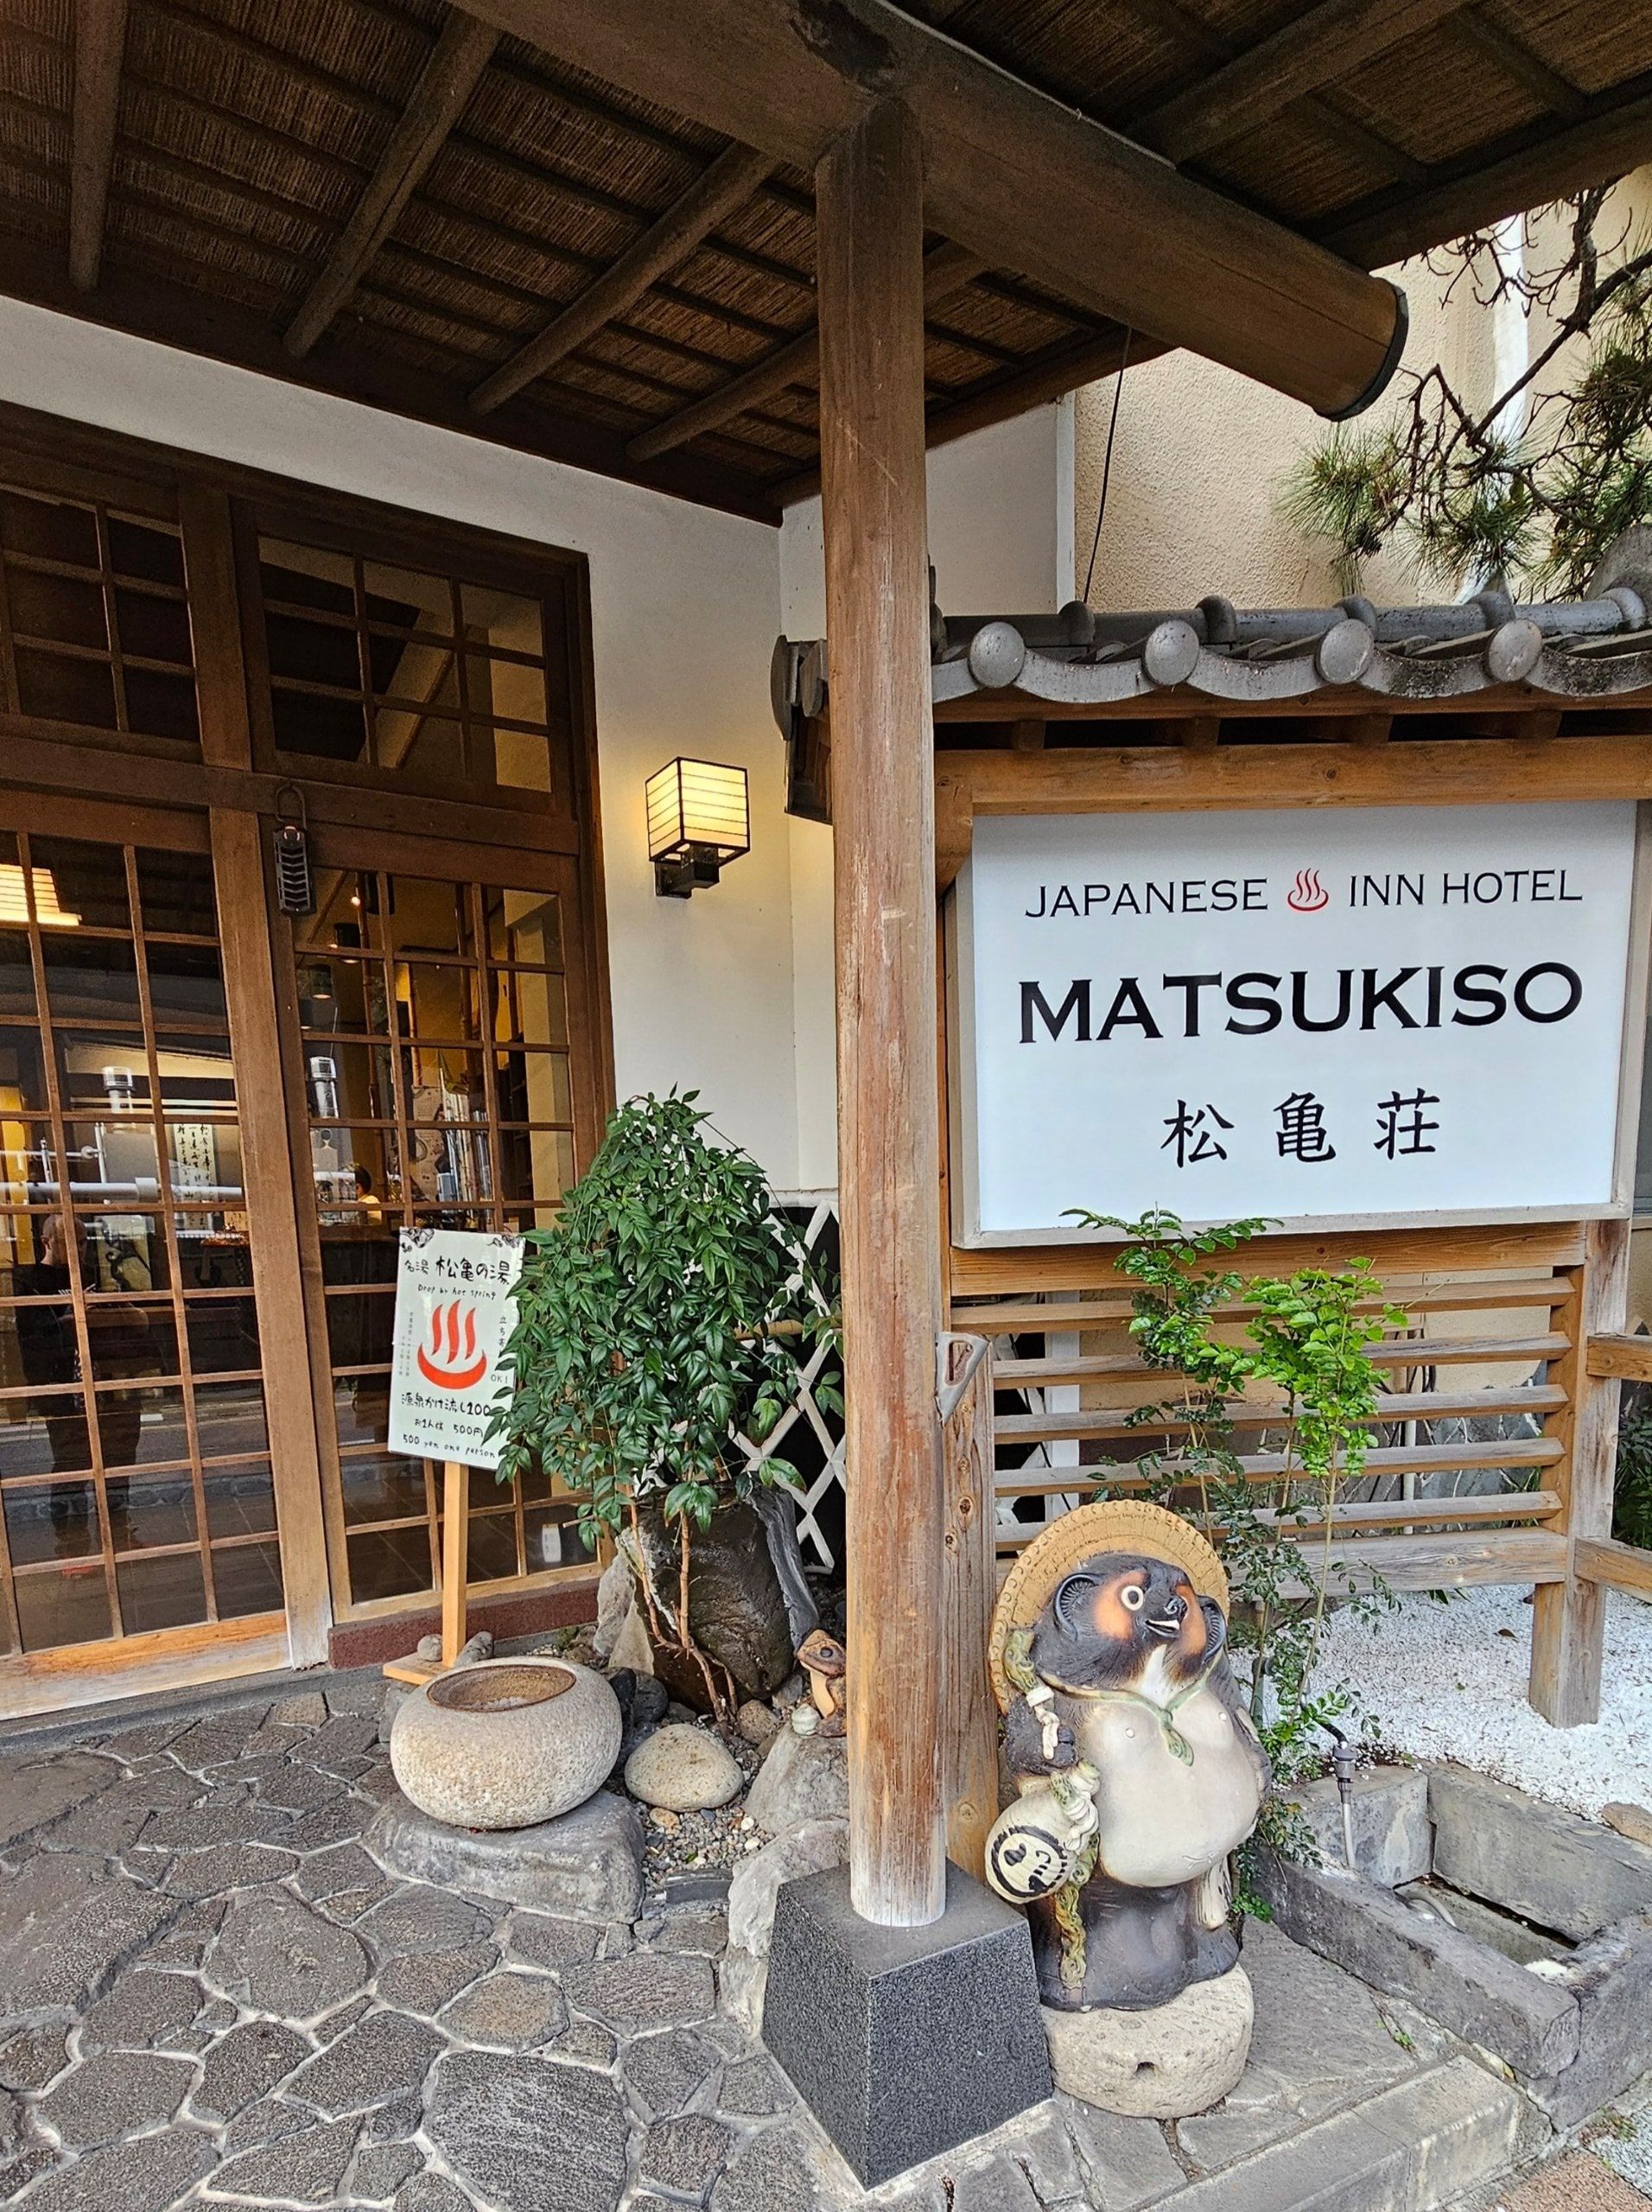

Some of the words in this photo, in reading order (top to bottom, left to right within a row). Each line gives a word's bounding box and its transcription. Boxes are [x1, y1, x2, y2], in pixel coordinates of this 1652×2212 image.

[1025, 878, 1268, 918] JAPANESE
[1350, 874, 1425, 908] INN
[1442, 869, 1583, 905] HOTEL
[1019, 962, 1583, 1044] MATSUKISO
[1160, 1088, 1441, 1168] 松亀荘
[435, 1255, 511, 1286] 松亀の湯
[471, 1289, 497, 1300] spring
[403, 1433, 420, 1445] 500
[424, 1440, 439, 1449] yen
[466, 1446, 496, 1459] person
[454, 1424, 484, 1438] 500円
